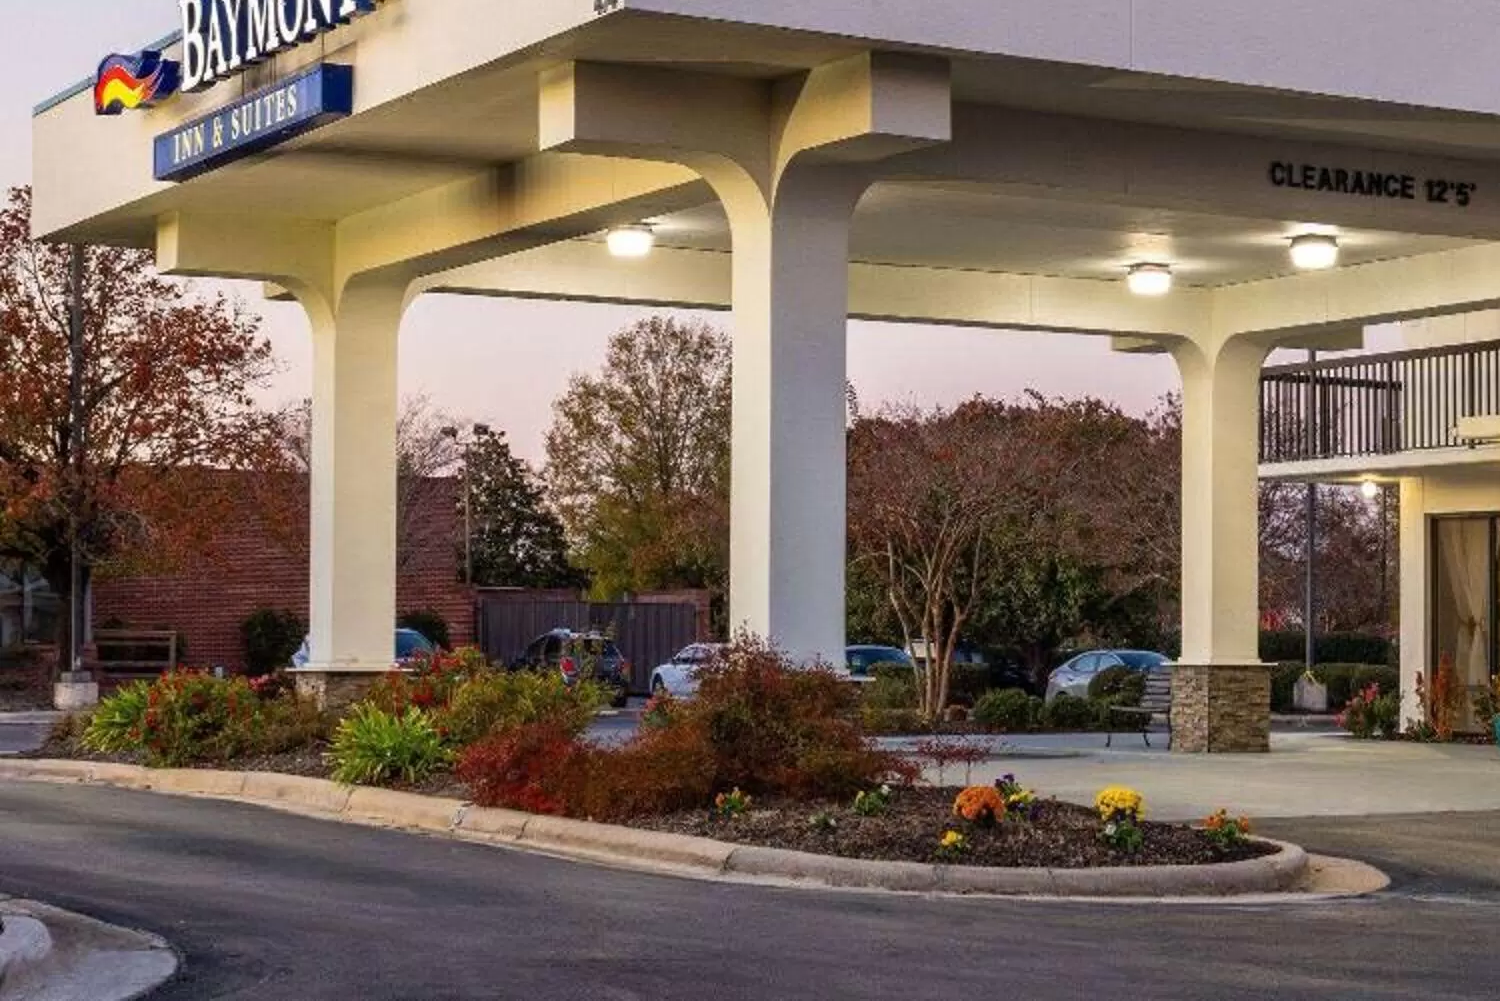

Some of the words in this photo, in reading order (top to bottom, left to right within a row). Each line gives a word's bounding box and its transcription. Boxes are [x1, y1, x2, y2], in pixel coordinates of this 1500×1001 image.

[173, 122, 205, 164] INN
[212, 116, 224, 148] &
[231, 84, 297, 140] SUITES
[1268, 161, 1415, 199] CLEARANCE
